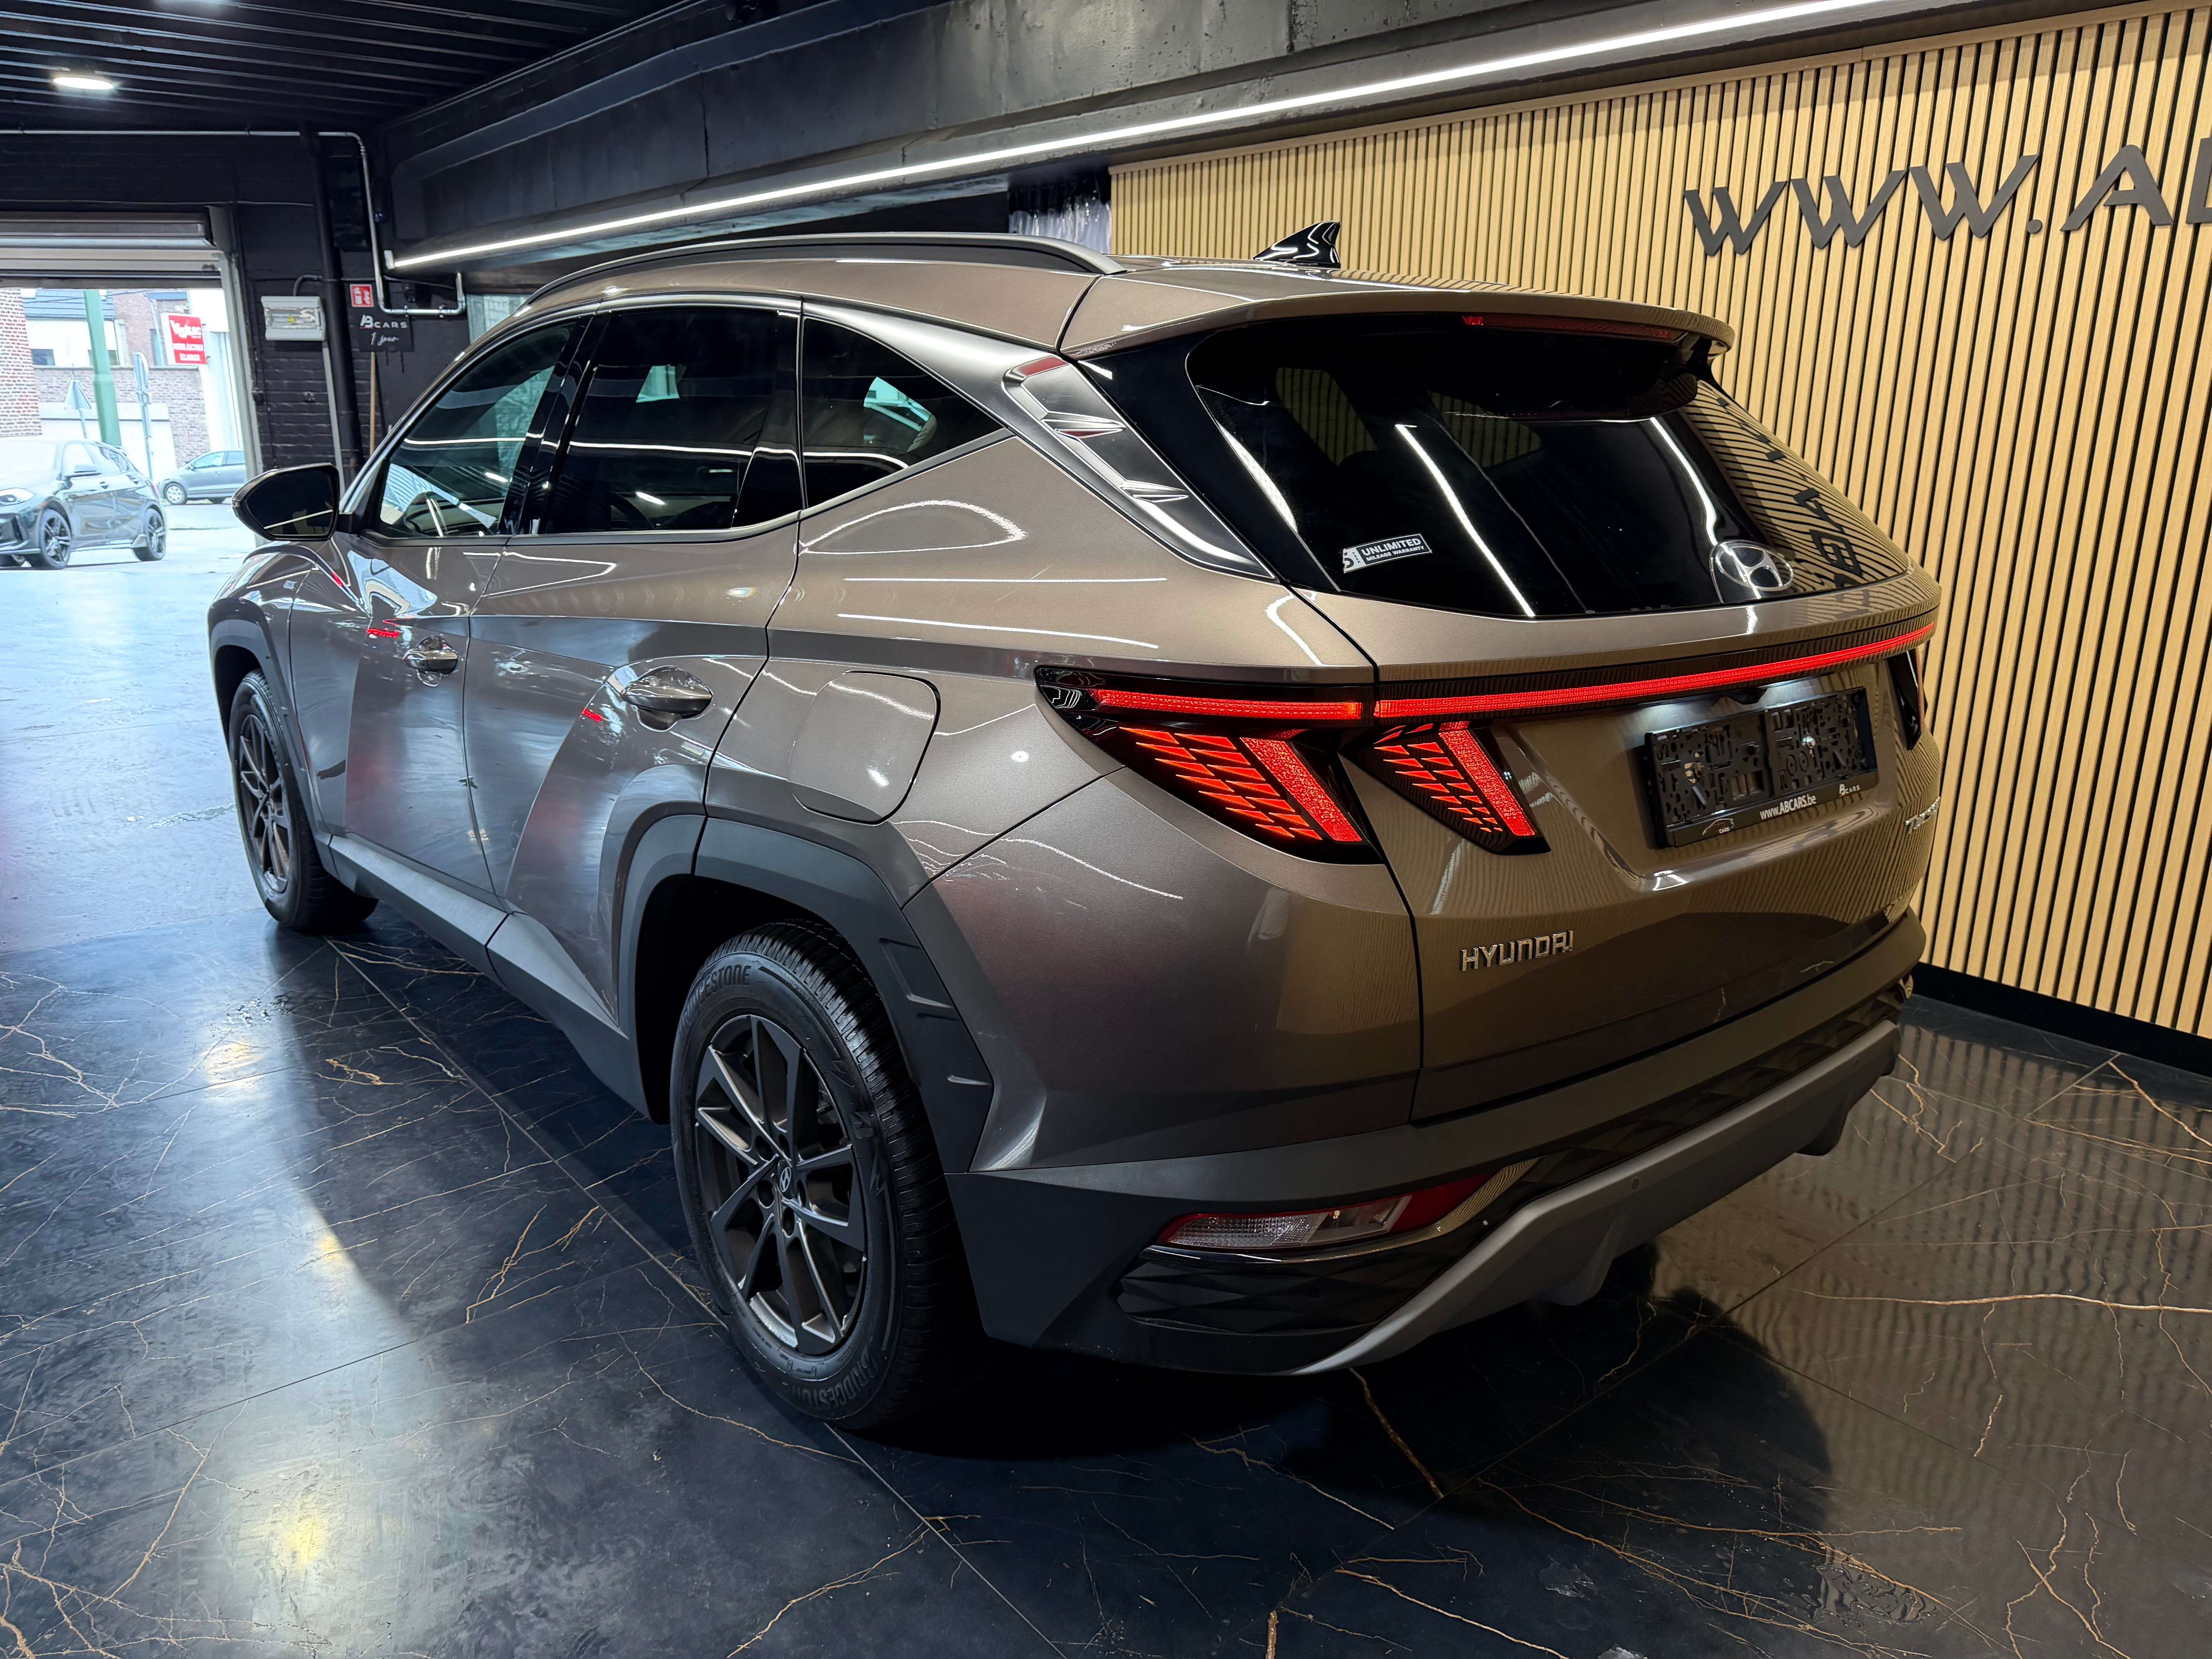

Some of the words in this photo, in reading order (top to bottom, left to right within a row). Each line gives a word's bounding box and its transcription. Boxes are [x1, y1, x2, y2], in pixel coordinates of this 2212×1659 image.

[1361, 538, 1421, 556] UNLIMITED
[1366, 552, 1392, 561] MILEAGE
[1392, 546, 1424, 555] WARRANTY
[1760, 794, 1817, 819] www.ABCARS.be
[1460, 930, 1574, 972] HYUNDAI
[782, 1344, 879, 1410] BRIDGESTON
